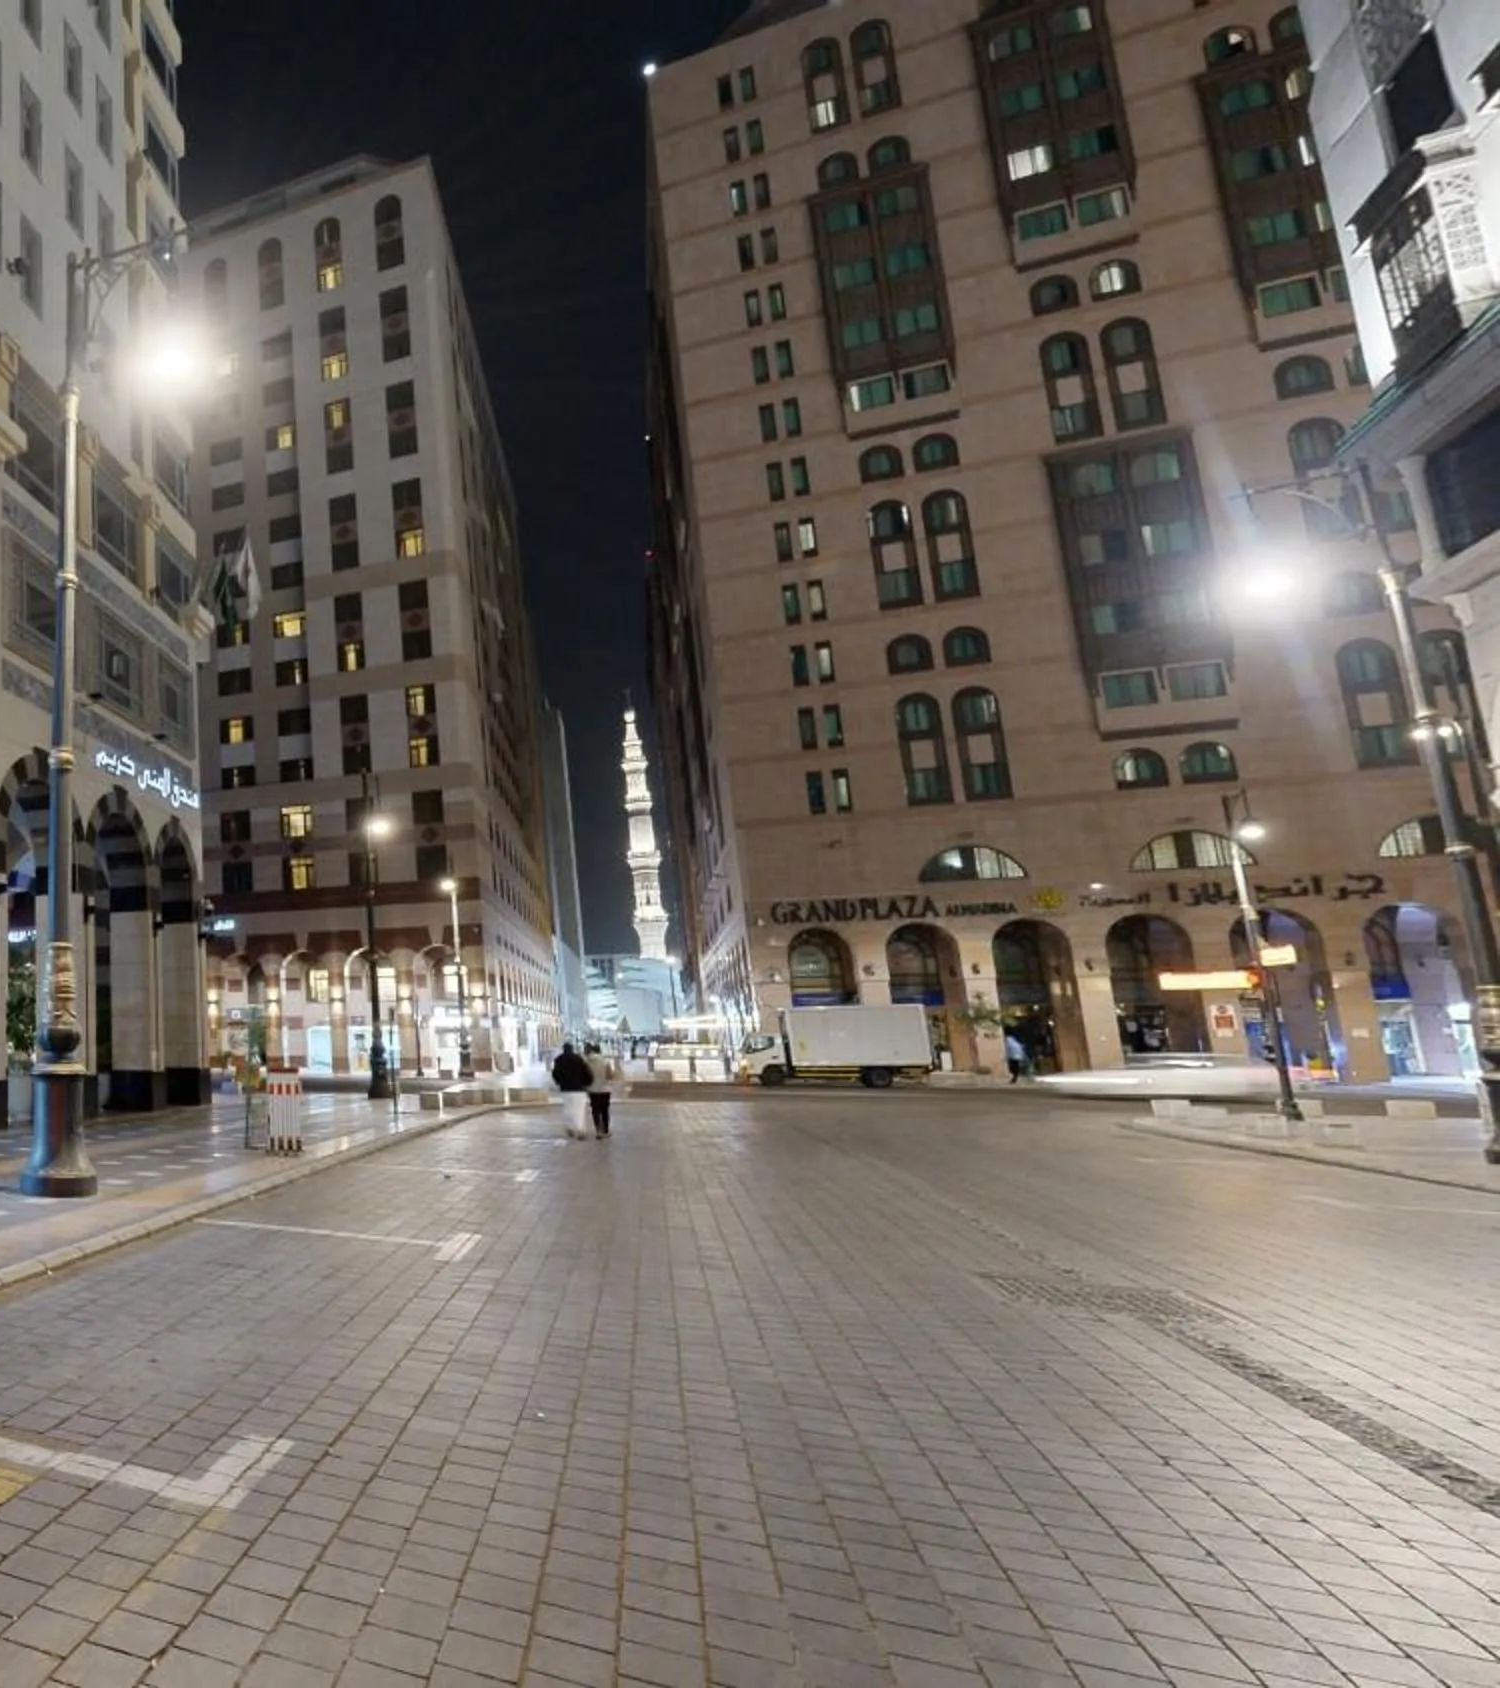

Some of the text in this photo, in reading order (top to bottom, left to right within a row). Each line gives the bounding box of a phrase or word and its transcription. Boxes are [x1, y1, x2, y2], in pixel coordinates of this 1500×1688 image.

[95, 751, 135, 776] كريم
[171, 777, 200, 809] فندق
[770, 899, 857, 926] GRAND
[859, 895, 941, 921] PLAZA
